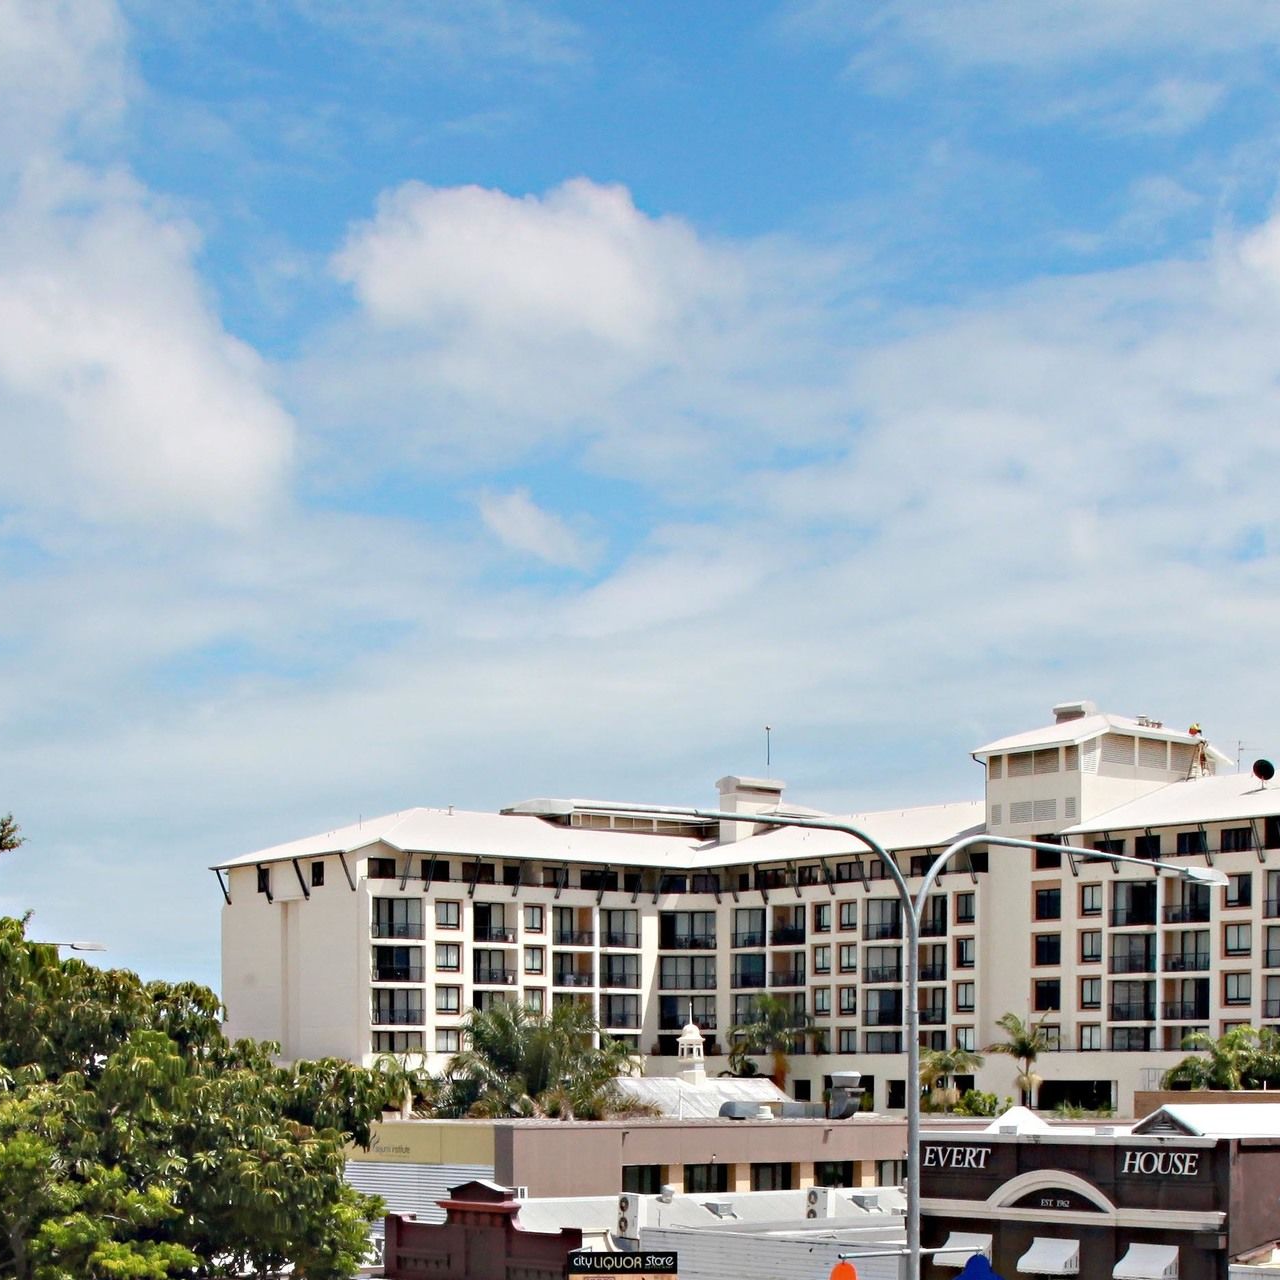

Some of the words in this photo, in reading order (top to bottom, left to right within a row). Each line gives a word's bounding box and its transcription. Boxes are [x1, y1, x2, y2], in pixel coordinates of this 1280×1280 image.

[923, 1146, 991, 1169] EVERT
[1122, 1151, 1199, 1176] HOUSE
[573, 1255, 593, 1268] city
[593, 1256, 642, 1270] LIQUOR
